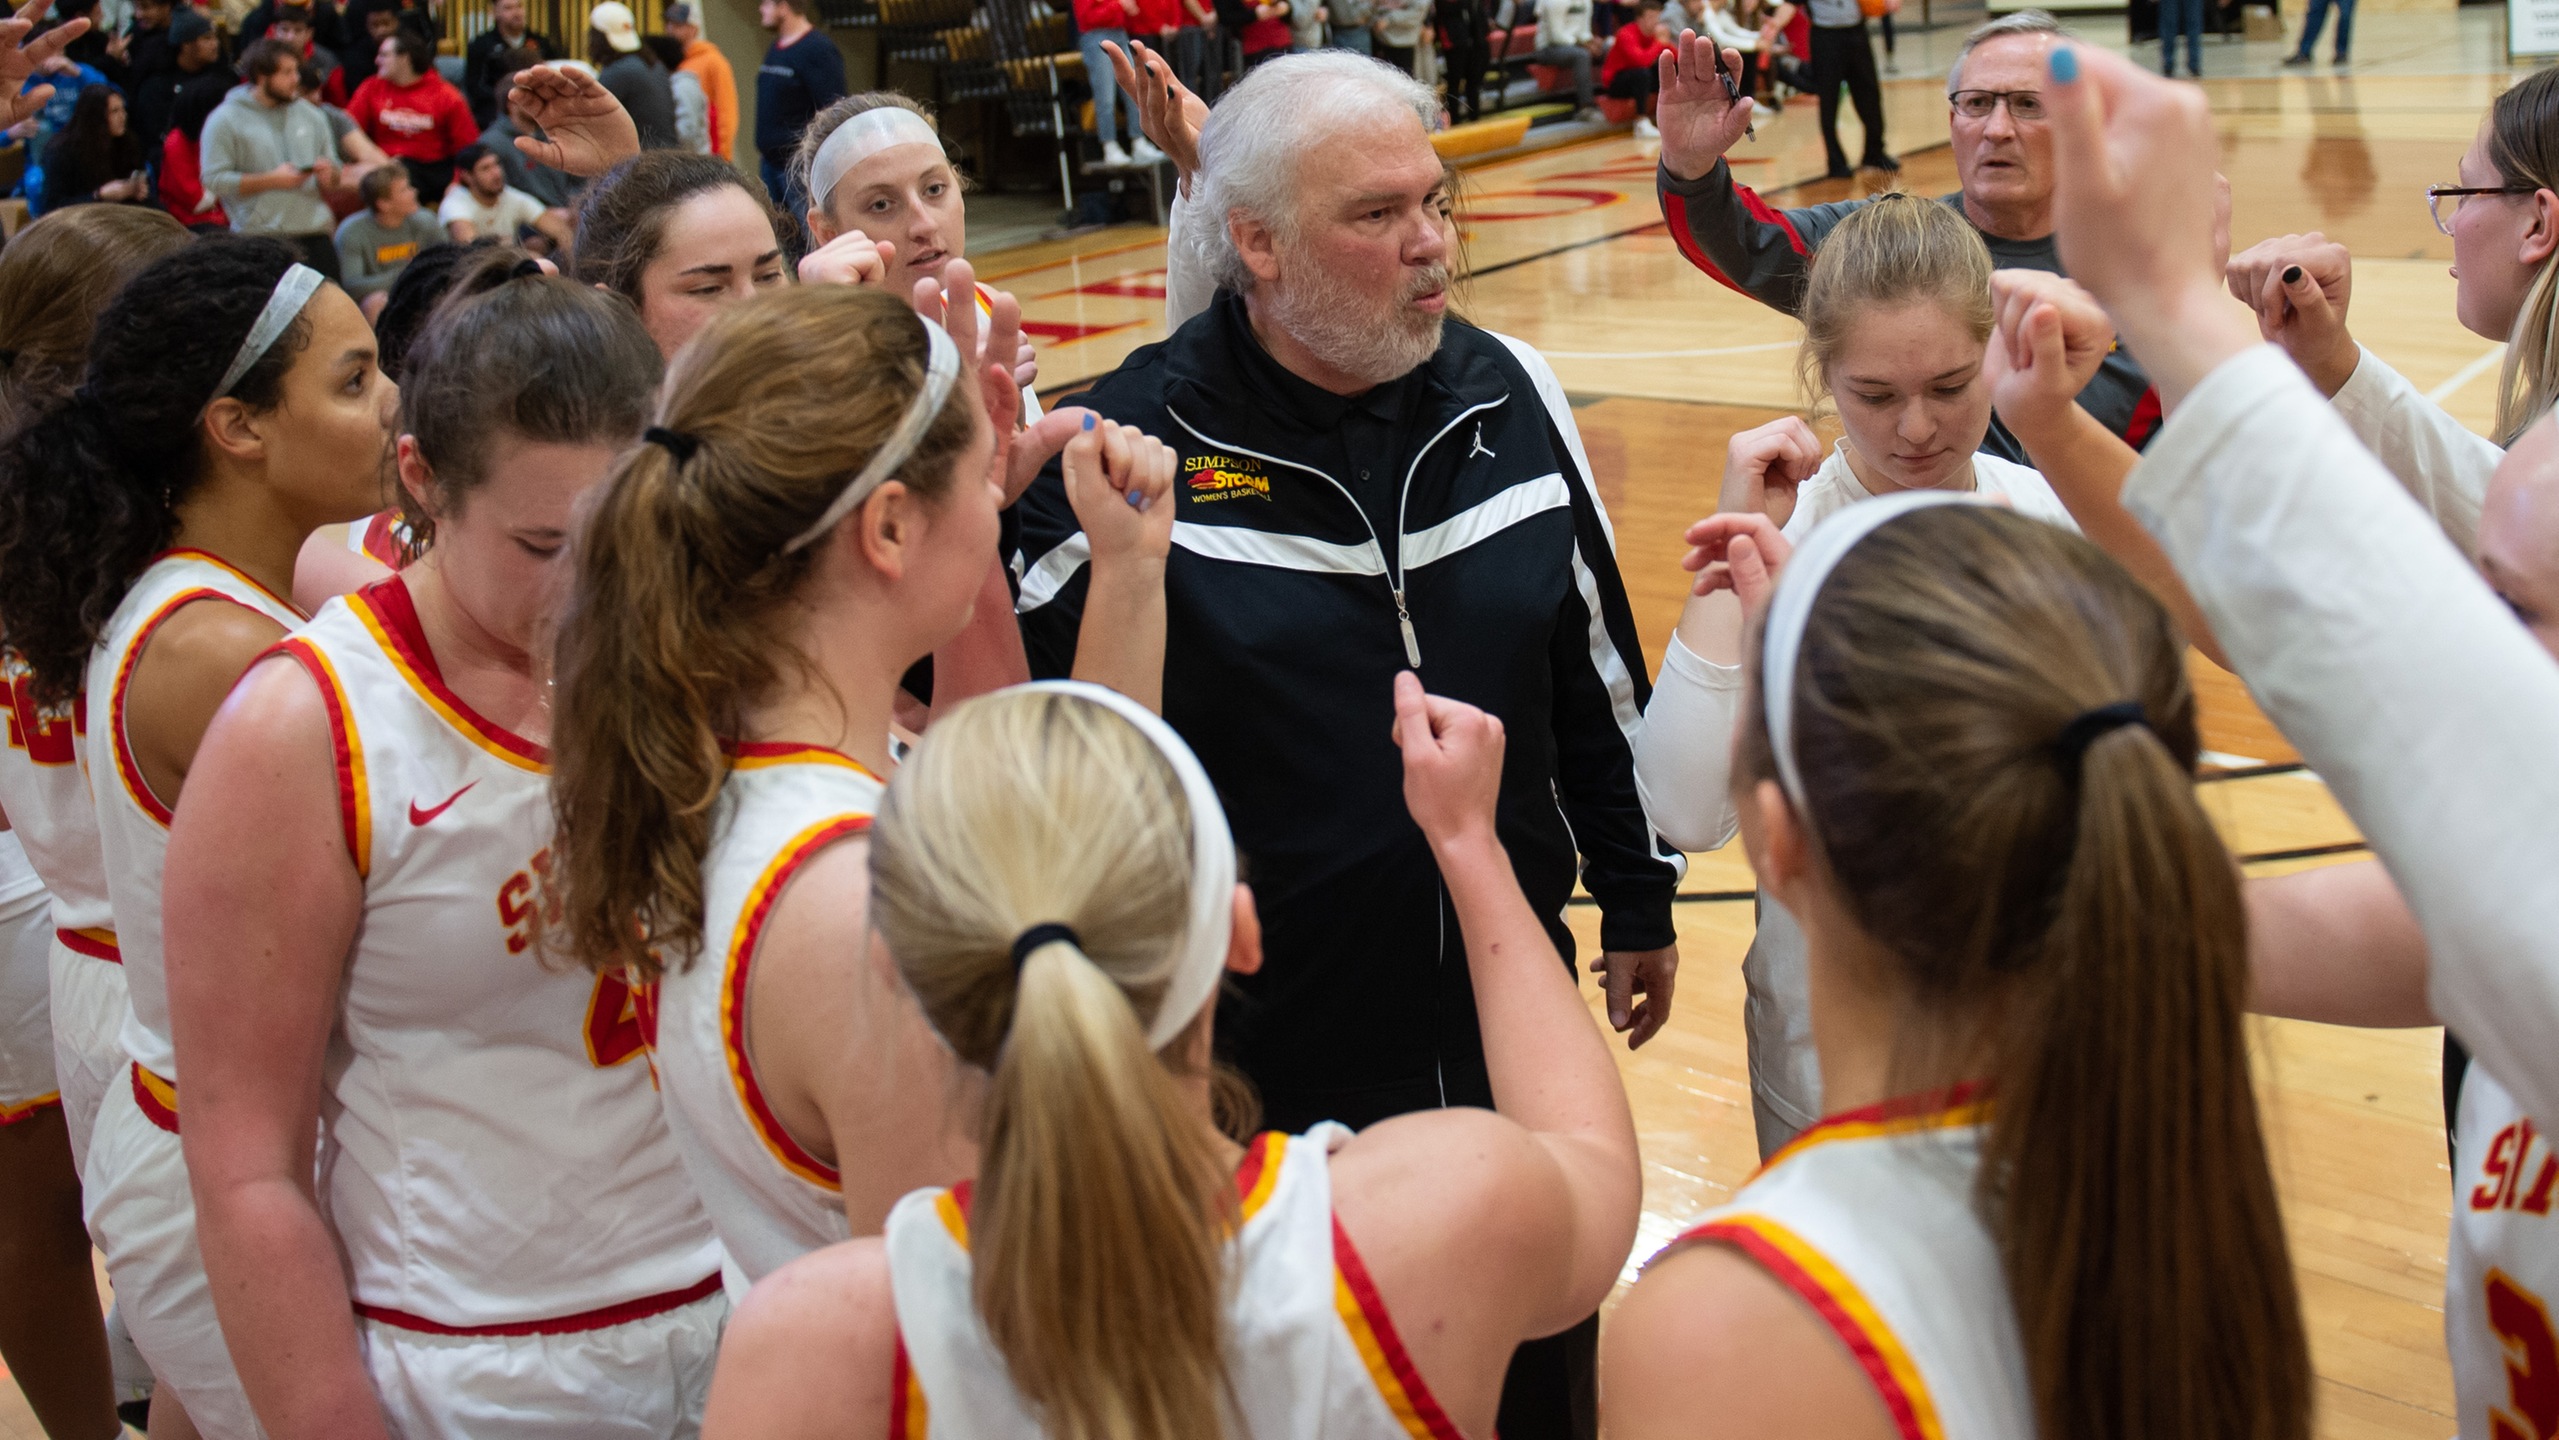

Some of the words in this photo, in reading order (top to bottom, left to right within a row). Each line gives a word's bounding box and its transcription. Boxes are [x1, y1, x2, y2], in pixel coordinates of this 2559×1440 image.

[1184, 455, 1262, 472] SIMPSON
[1213, 470, 1270, 493] STORM
[1191, 491, 1229, 503] WOMEN'S
